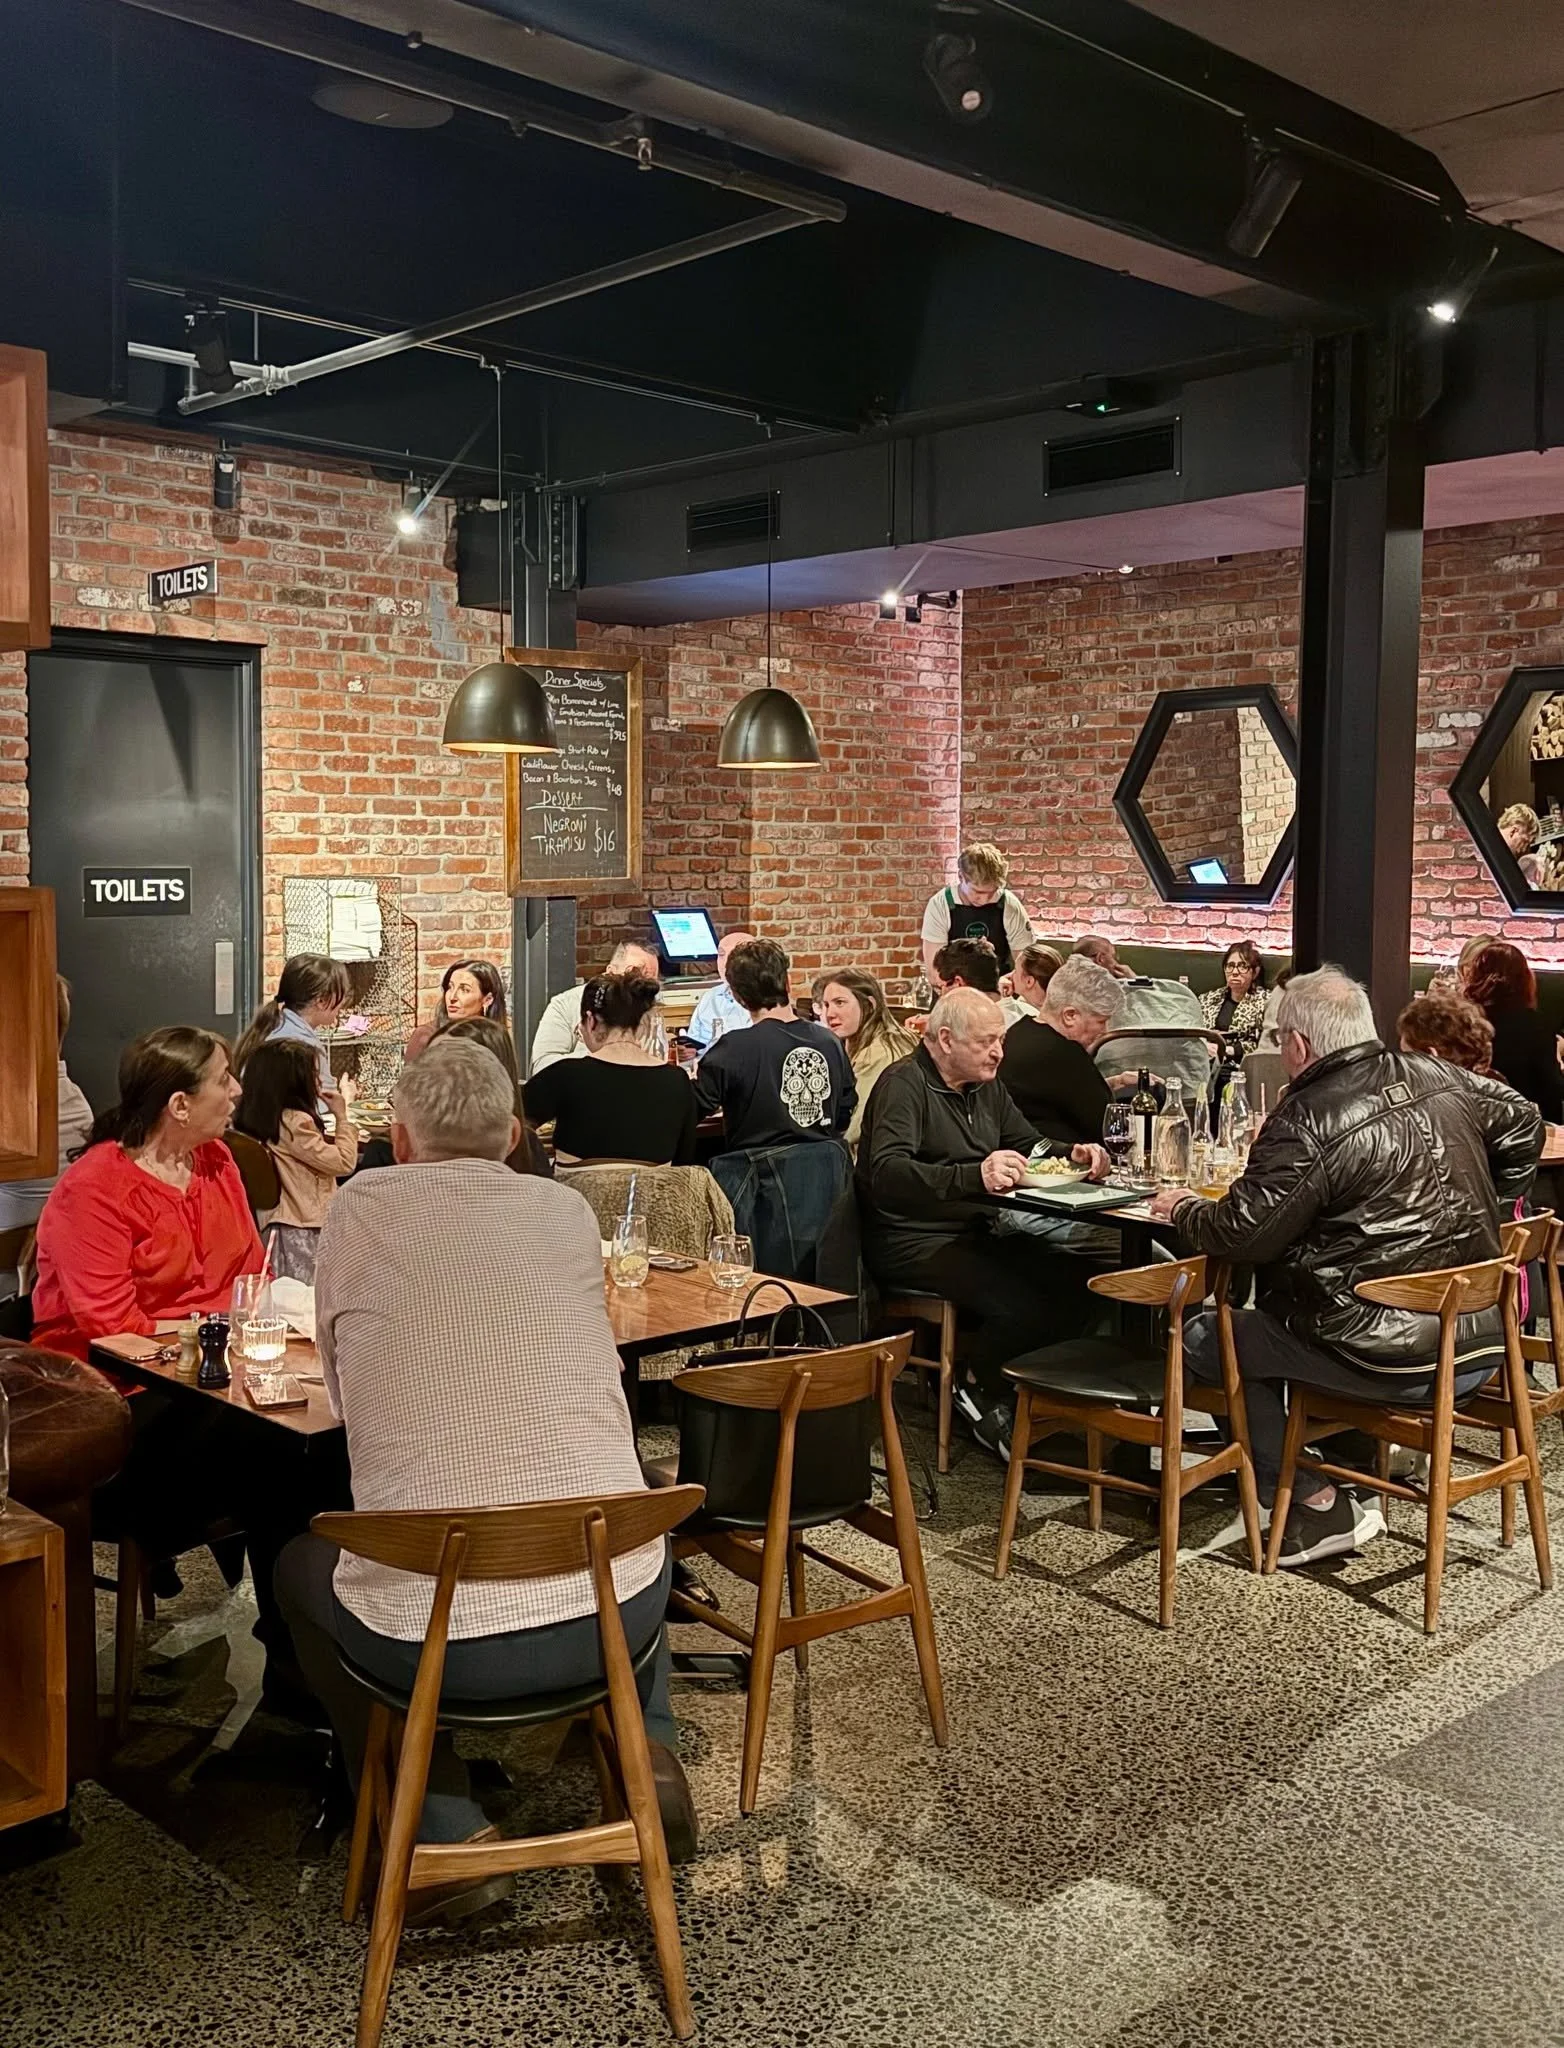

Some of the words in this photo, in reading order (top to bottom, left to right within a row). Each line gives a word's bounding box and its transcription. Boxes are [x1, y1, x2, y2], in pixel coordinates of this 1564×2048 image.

[157, 566, 208, 597] TOILETS
[546, 670, 571, 684] Dinner
[522, 772, 544, 783] Bacon
[553, 772, 582, 784] Bourbon
[606, 776, 622, 798] $48
[594, 819, 615, 858] $16
[90, 878, 184, 903] TOILETS
